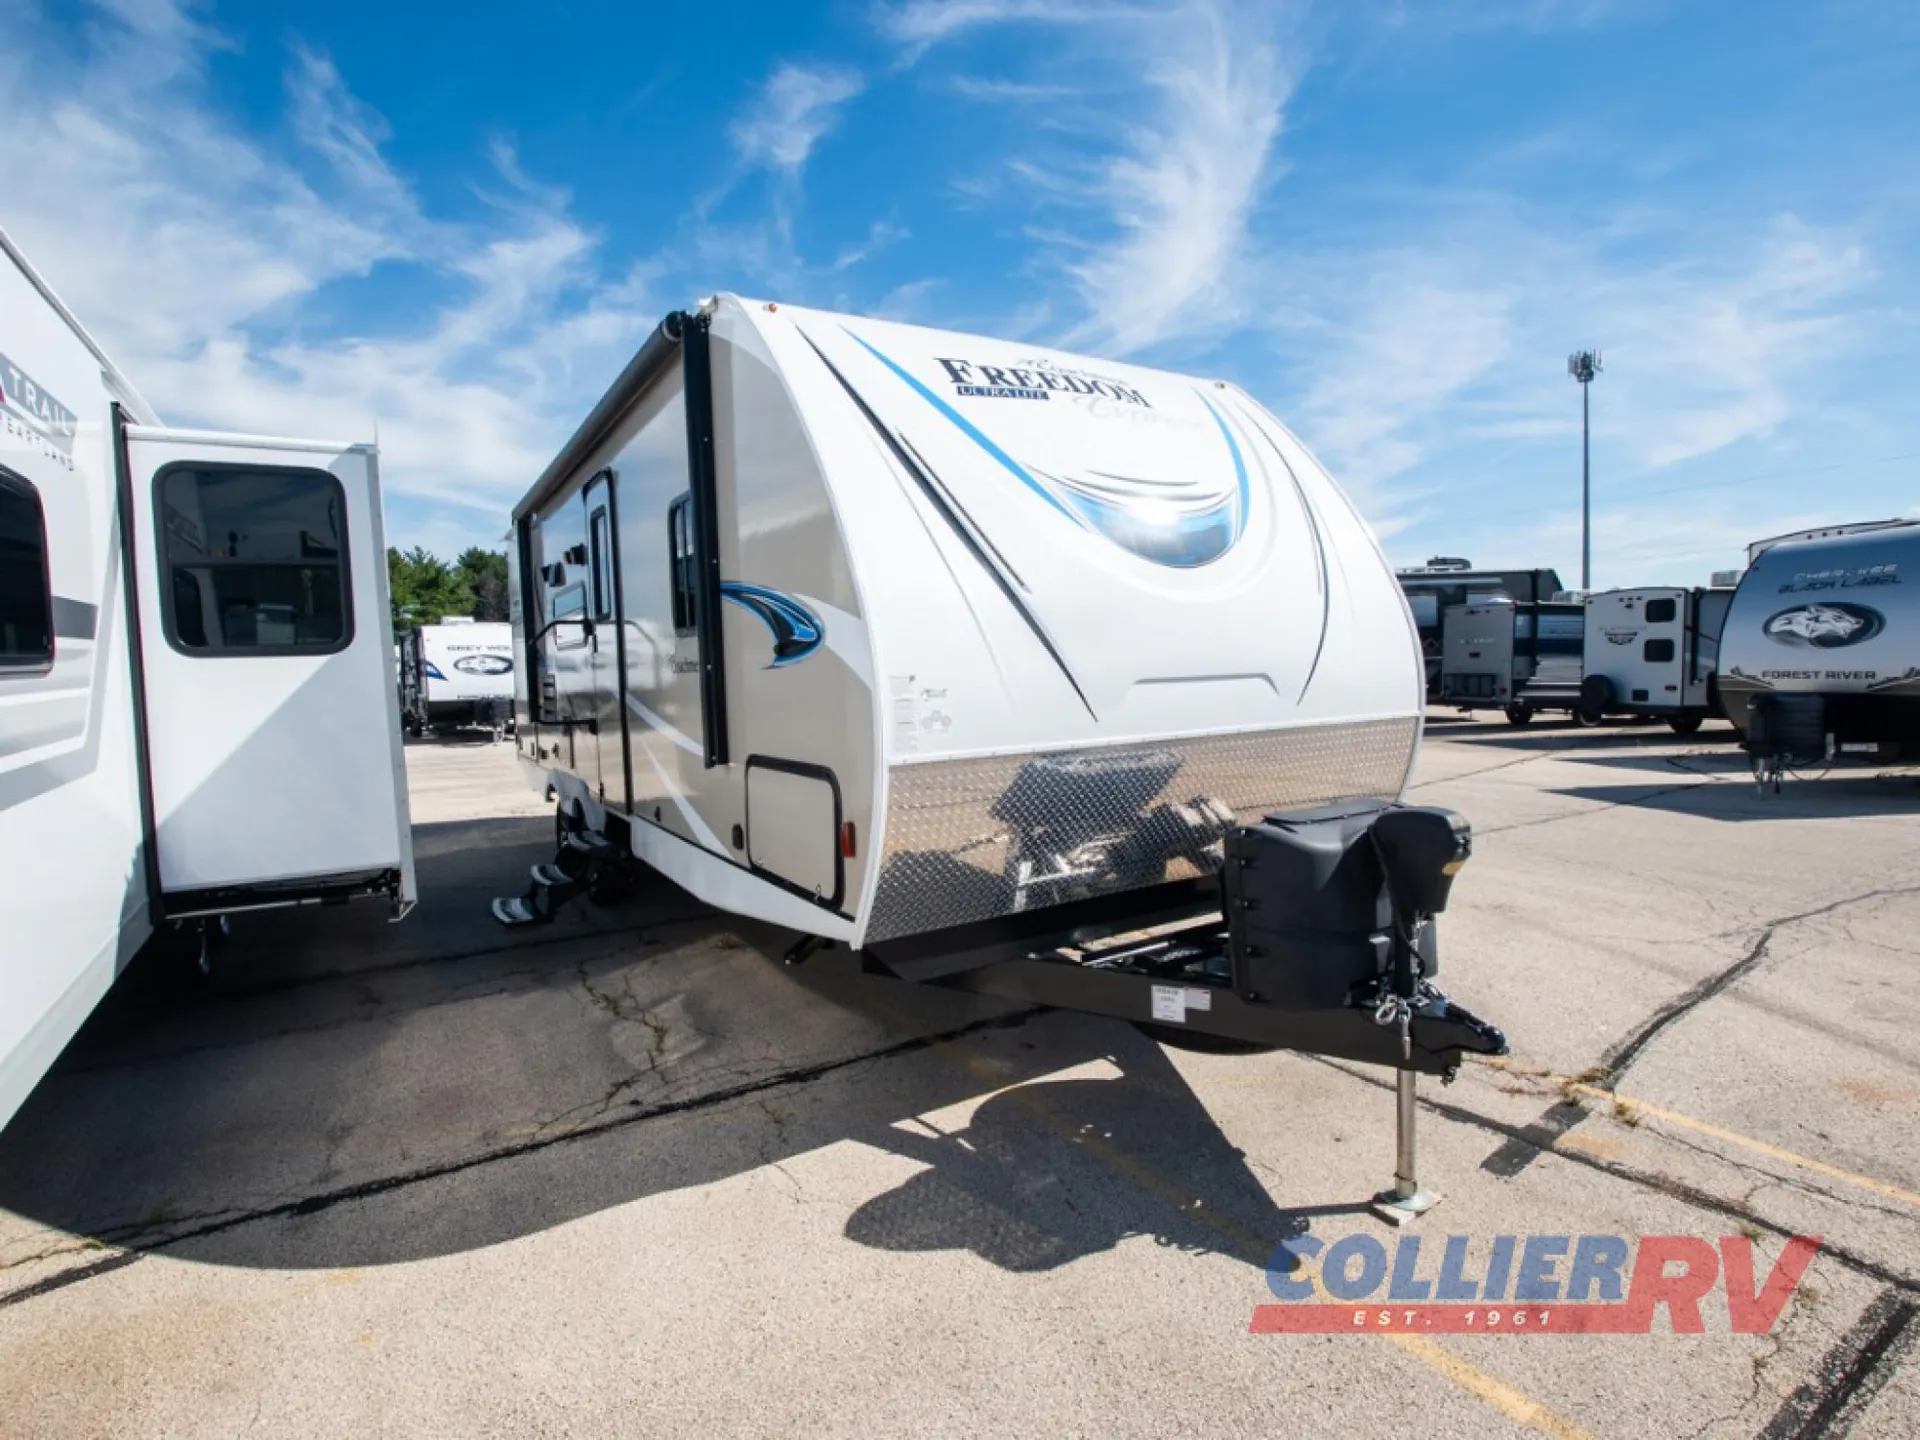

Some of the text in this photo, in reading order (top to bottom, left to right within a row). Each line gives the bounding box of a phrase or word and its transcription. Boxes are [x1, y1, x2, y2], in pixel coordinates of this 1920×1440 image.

[8, 364, 71, 437] TRAIL
[934, 356, 1154, 409] FREEDOM
[1778, 574, 1904, 594] BLACK LABEL
[1761, 669, 1876, 680] FOREST RIVER
